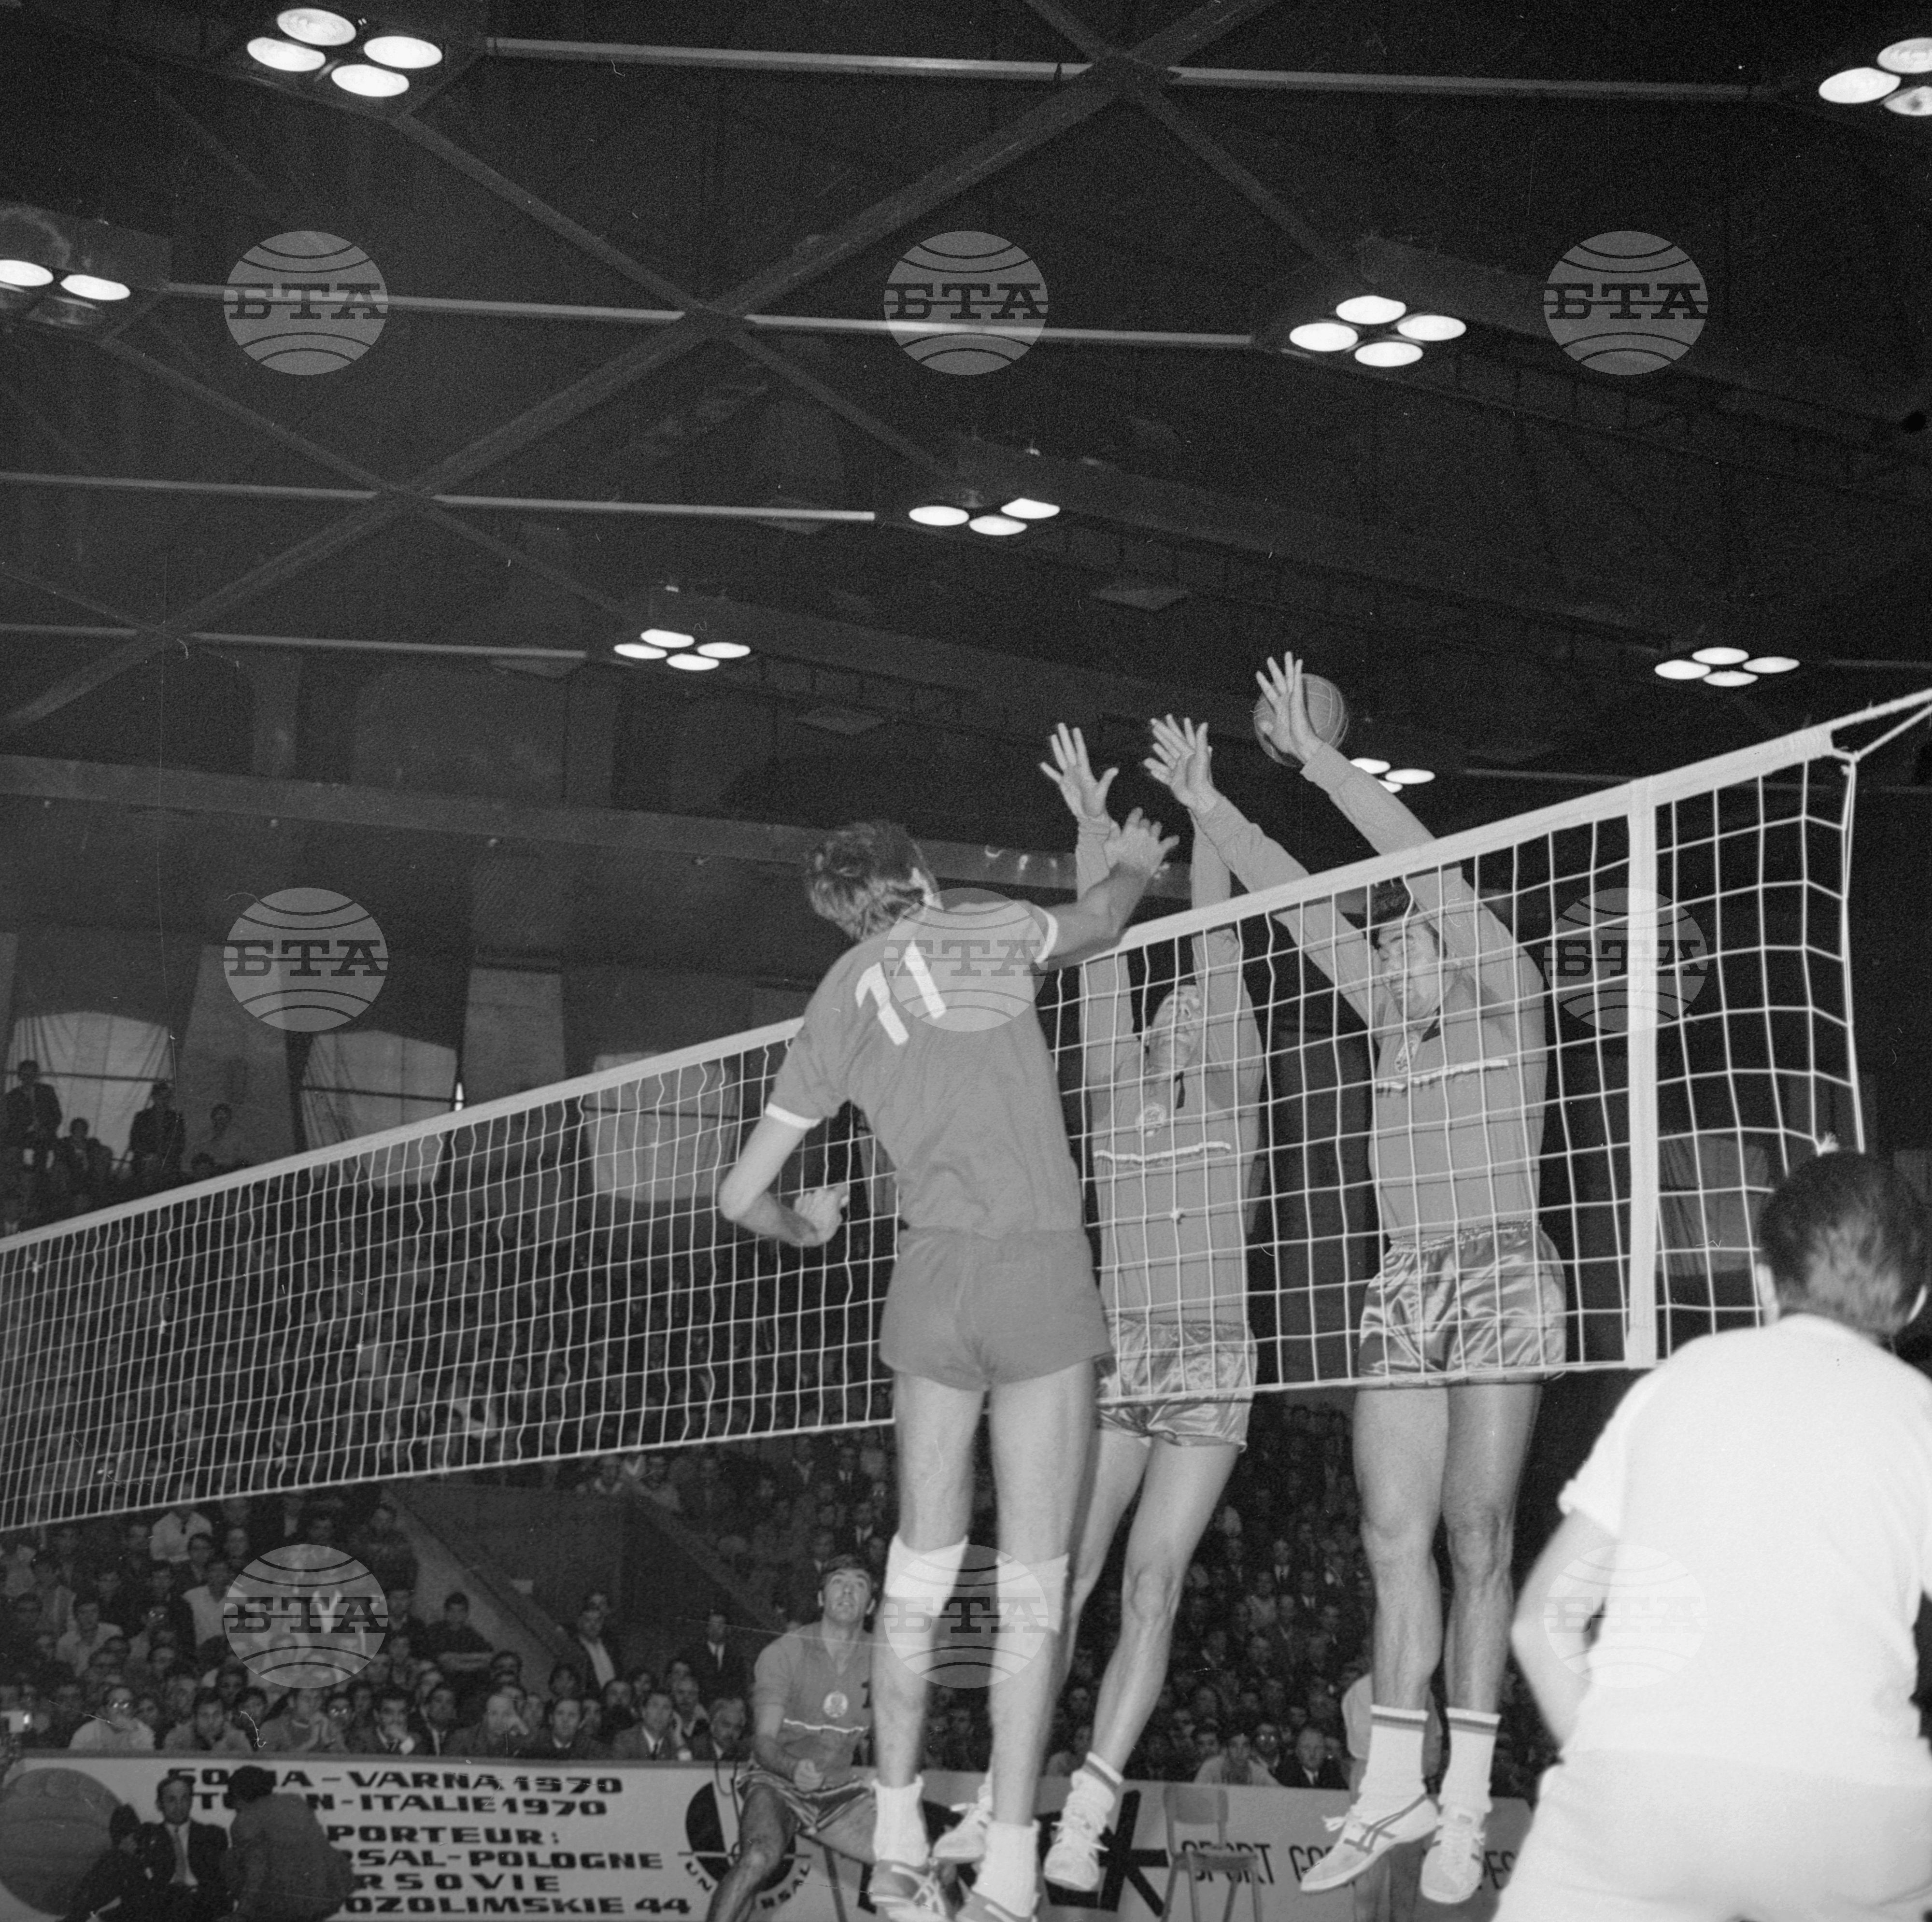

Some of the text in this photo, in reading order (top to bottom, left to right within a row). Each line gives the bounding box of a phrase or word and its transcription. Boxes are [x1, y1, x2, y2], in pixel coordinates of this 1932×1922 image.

[854, 937, 948, 1045] 11
[513, 1776, 623, 1795] 1970
[502, 1797, 607, 1816] 1970
[354, 1872, 560, 1893] RSOVIE
[345, 1896, 692, 1916] OZOLIMSKIE 44
